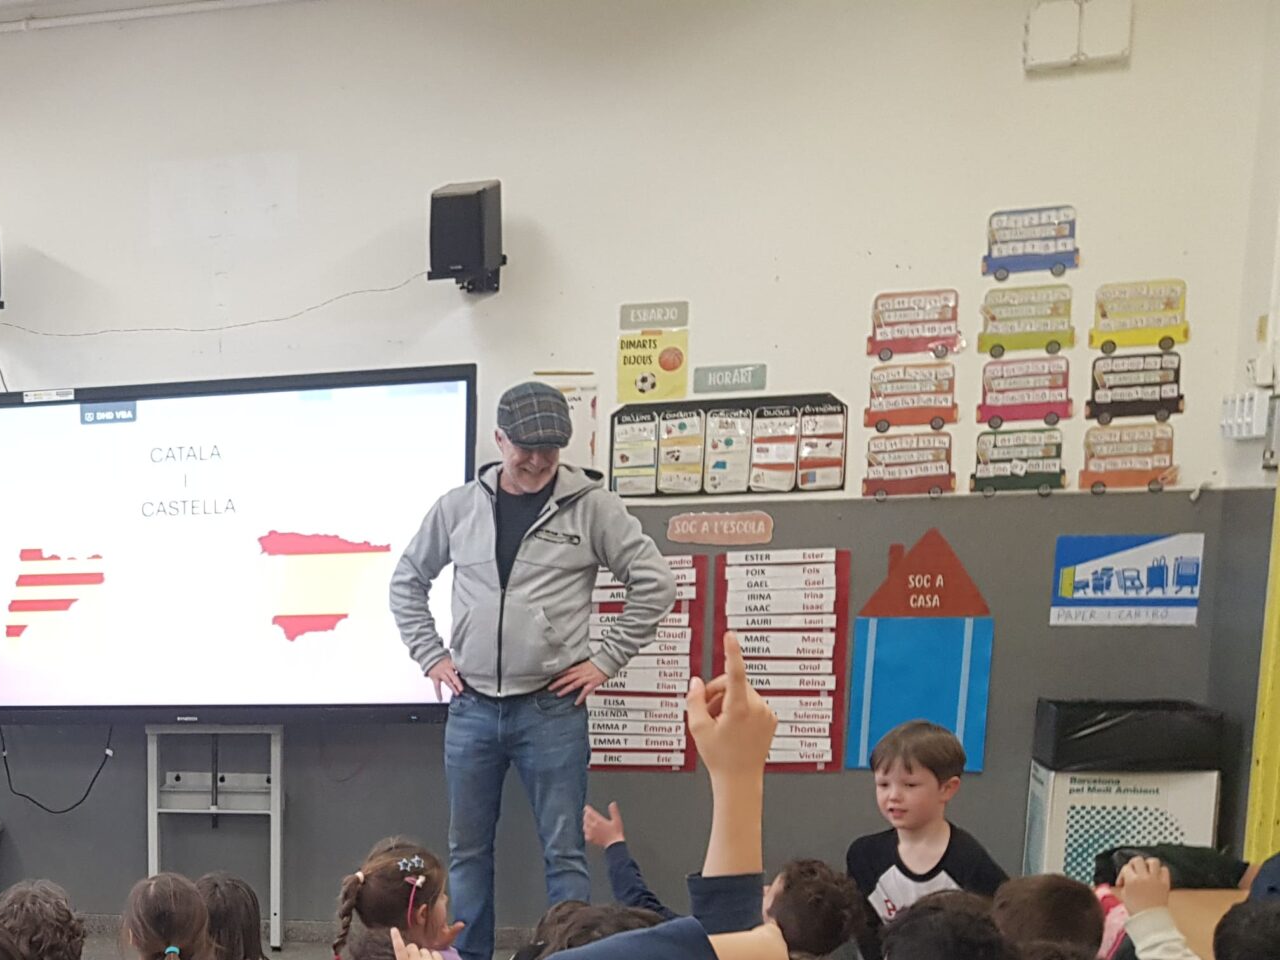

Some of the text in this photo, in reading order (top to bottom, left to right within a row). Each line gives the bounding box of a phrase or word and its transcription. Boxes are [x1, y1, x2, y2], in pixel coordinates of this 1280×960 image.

[620, 339, 658, 350] DIMARTS
[623, 355, 653, 365] DIJOUS
[141, 499, 236, 517] CASTELLA
[675, 521, 697, 533] SOC
[701, 521, 709, 533] A
[745, 552, 824, 562] ESTER Ester
[804, 578, 825, 586] Gael
[908, 574, 944, 589] SOC A
[910, 594, 940, 608] CASA
[802, 603, 824, 611] Isaac
[1057, 608, 1096, 621] PAPER
[746, 618, 772, 626] LAURI
[657, 631, 687, 639] Claudi
[744, 635, 771, 643] MARC
[799, 663, 821, 671] Oriol
[799, 679, 826, 687] Reina
[644, 711, 678, 719] Elisenda
[592, 723, 619, 731] EMMA
[644, 725, 673, 733] Emma
[675, 725, 682, 734] P
[790, 725, 827, 733] Thomas
[800, 740, 818, 748] Tian
[1069, 777, 1120, 785] Barcelona
[1069, 786, 1085, 794] pel
[1116, 786, 1159, 794] Ambient
